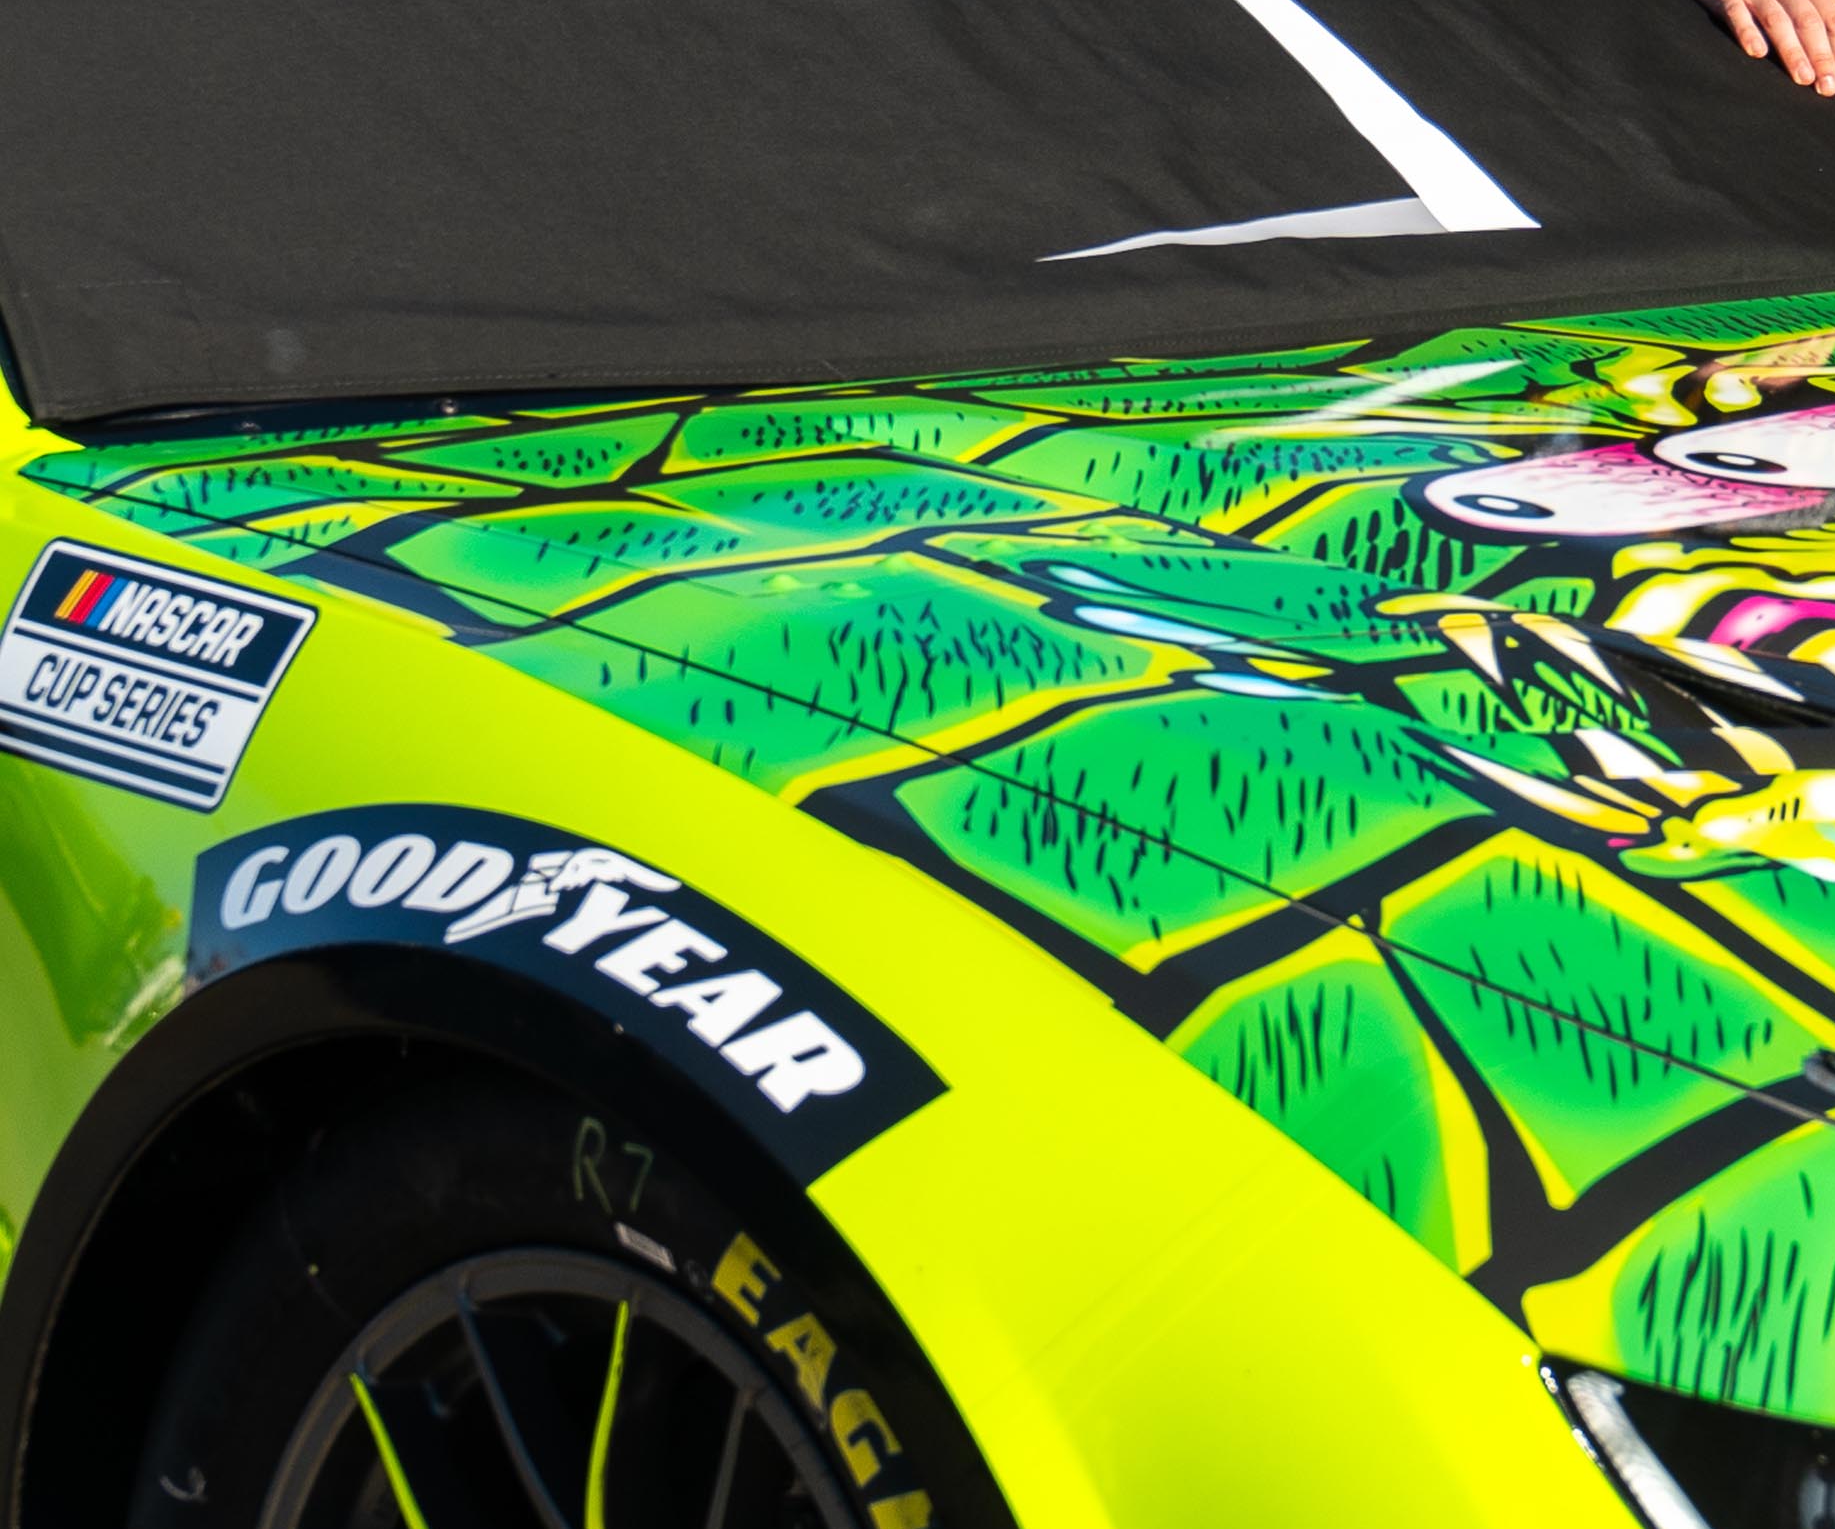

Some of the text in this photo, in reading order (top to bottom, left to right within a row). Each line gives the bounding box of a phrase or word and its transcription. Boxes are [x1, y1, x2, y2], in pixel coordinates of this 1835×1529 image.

[98, 580, 264, 668] NASCAR
[24, 653, 221, 748] CUP SERIES
[220, 834, 866, 1113] GOODYEAR
